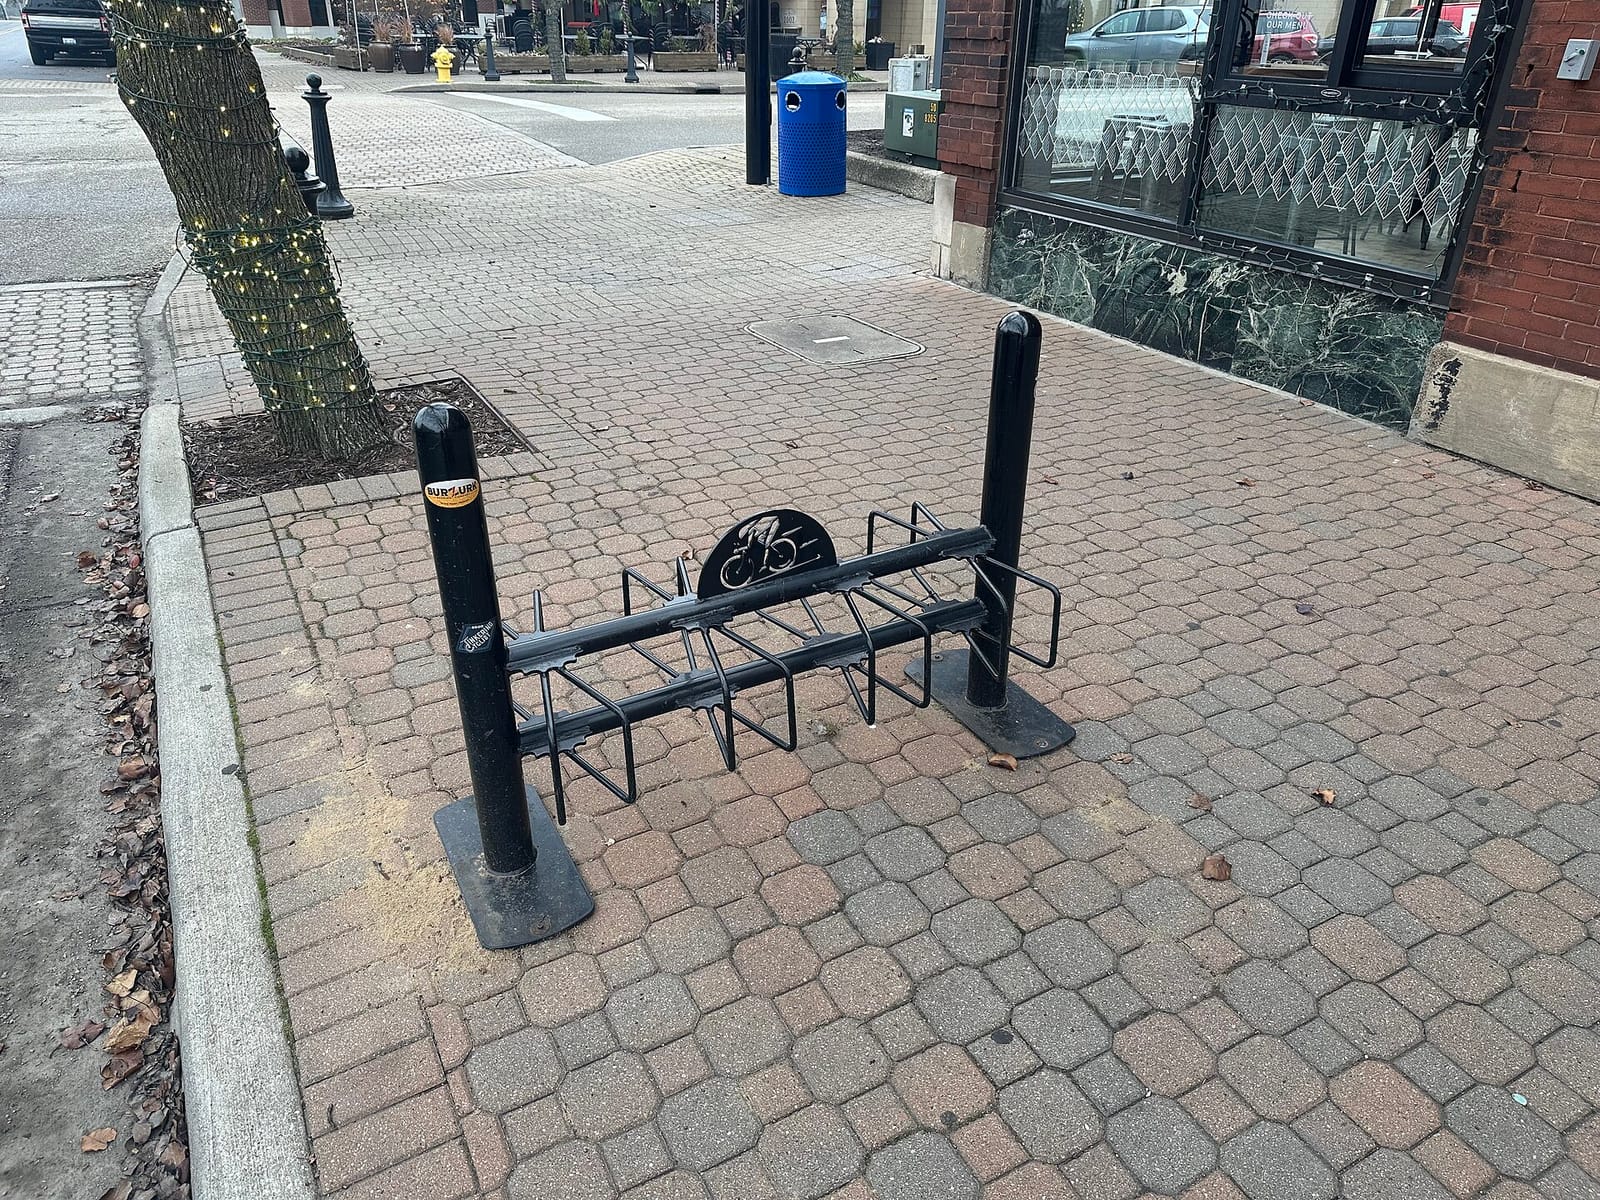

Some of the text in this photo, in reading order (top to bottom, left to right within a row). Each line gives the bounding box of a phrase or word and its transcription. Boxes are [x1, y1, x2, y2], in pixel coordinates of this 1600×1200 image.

[1266, 11, 1313, 20] CHECK OUT
[1266, 21, 1308, 29] OUR MENU
